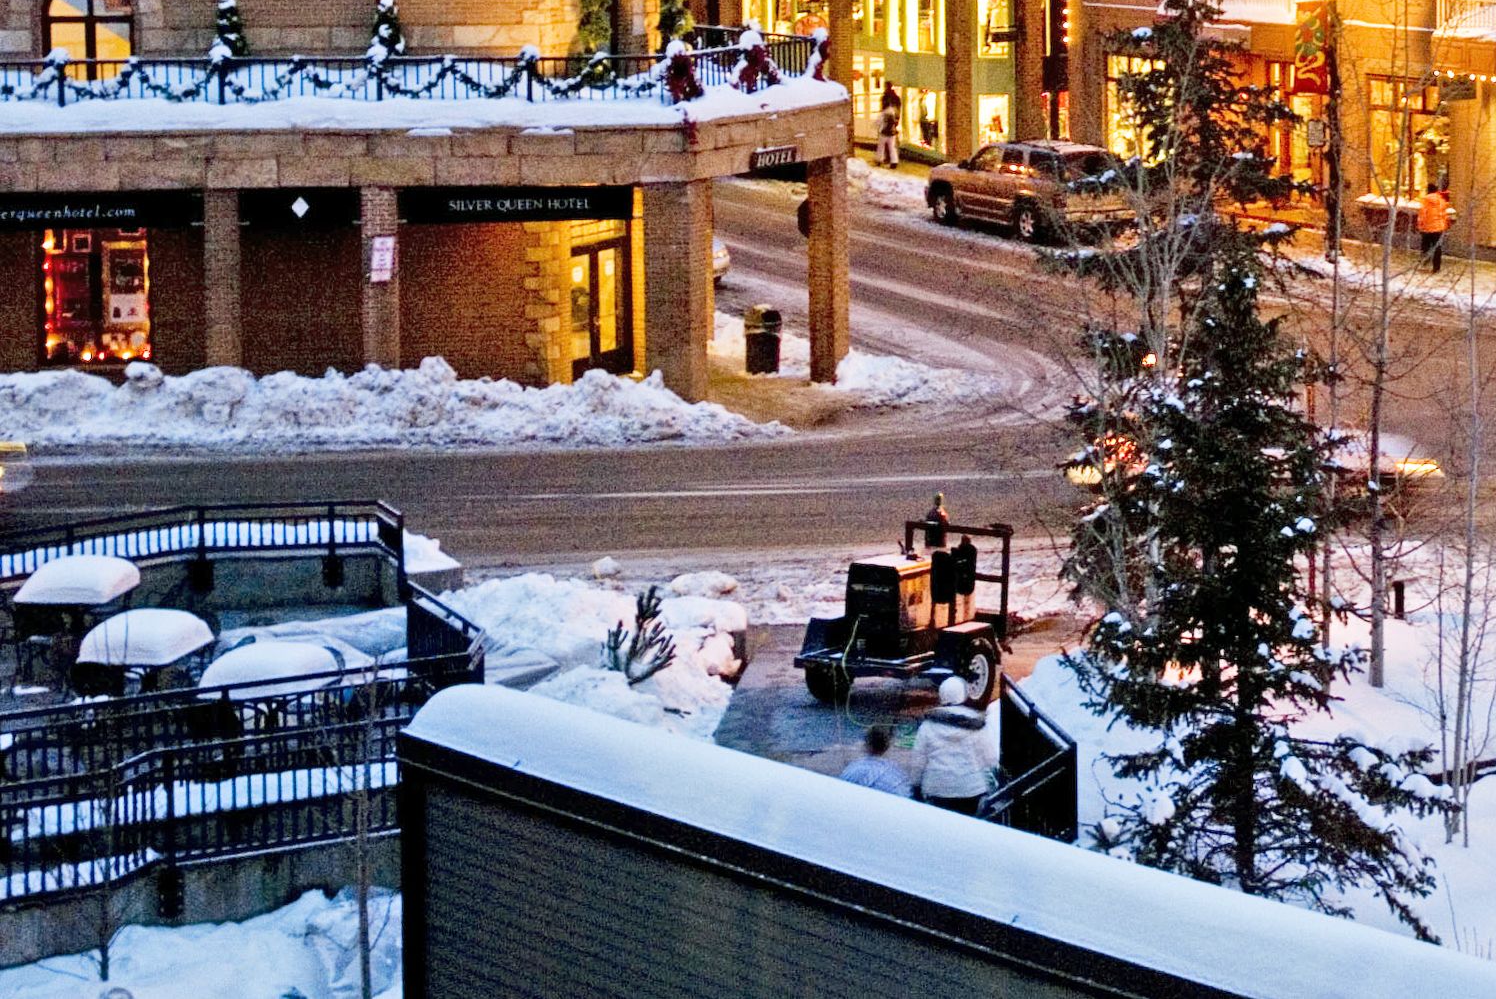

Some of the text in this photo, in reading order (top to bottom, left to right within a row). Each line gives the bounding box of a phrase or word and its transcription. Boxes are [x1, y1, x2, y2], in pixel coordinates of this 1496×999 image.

[757, 149, 793, 167] HOTEL
[448, 197, 591, 212] SILVER QUEEN HOTEL
